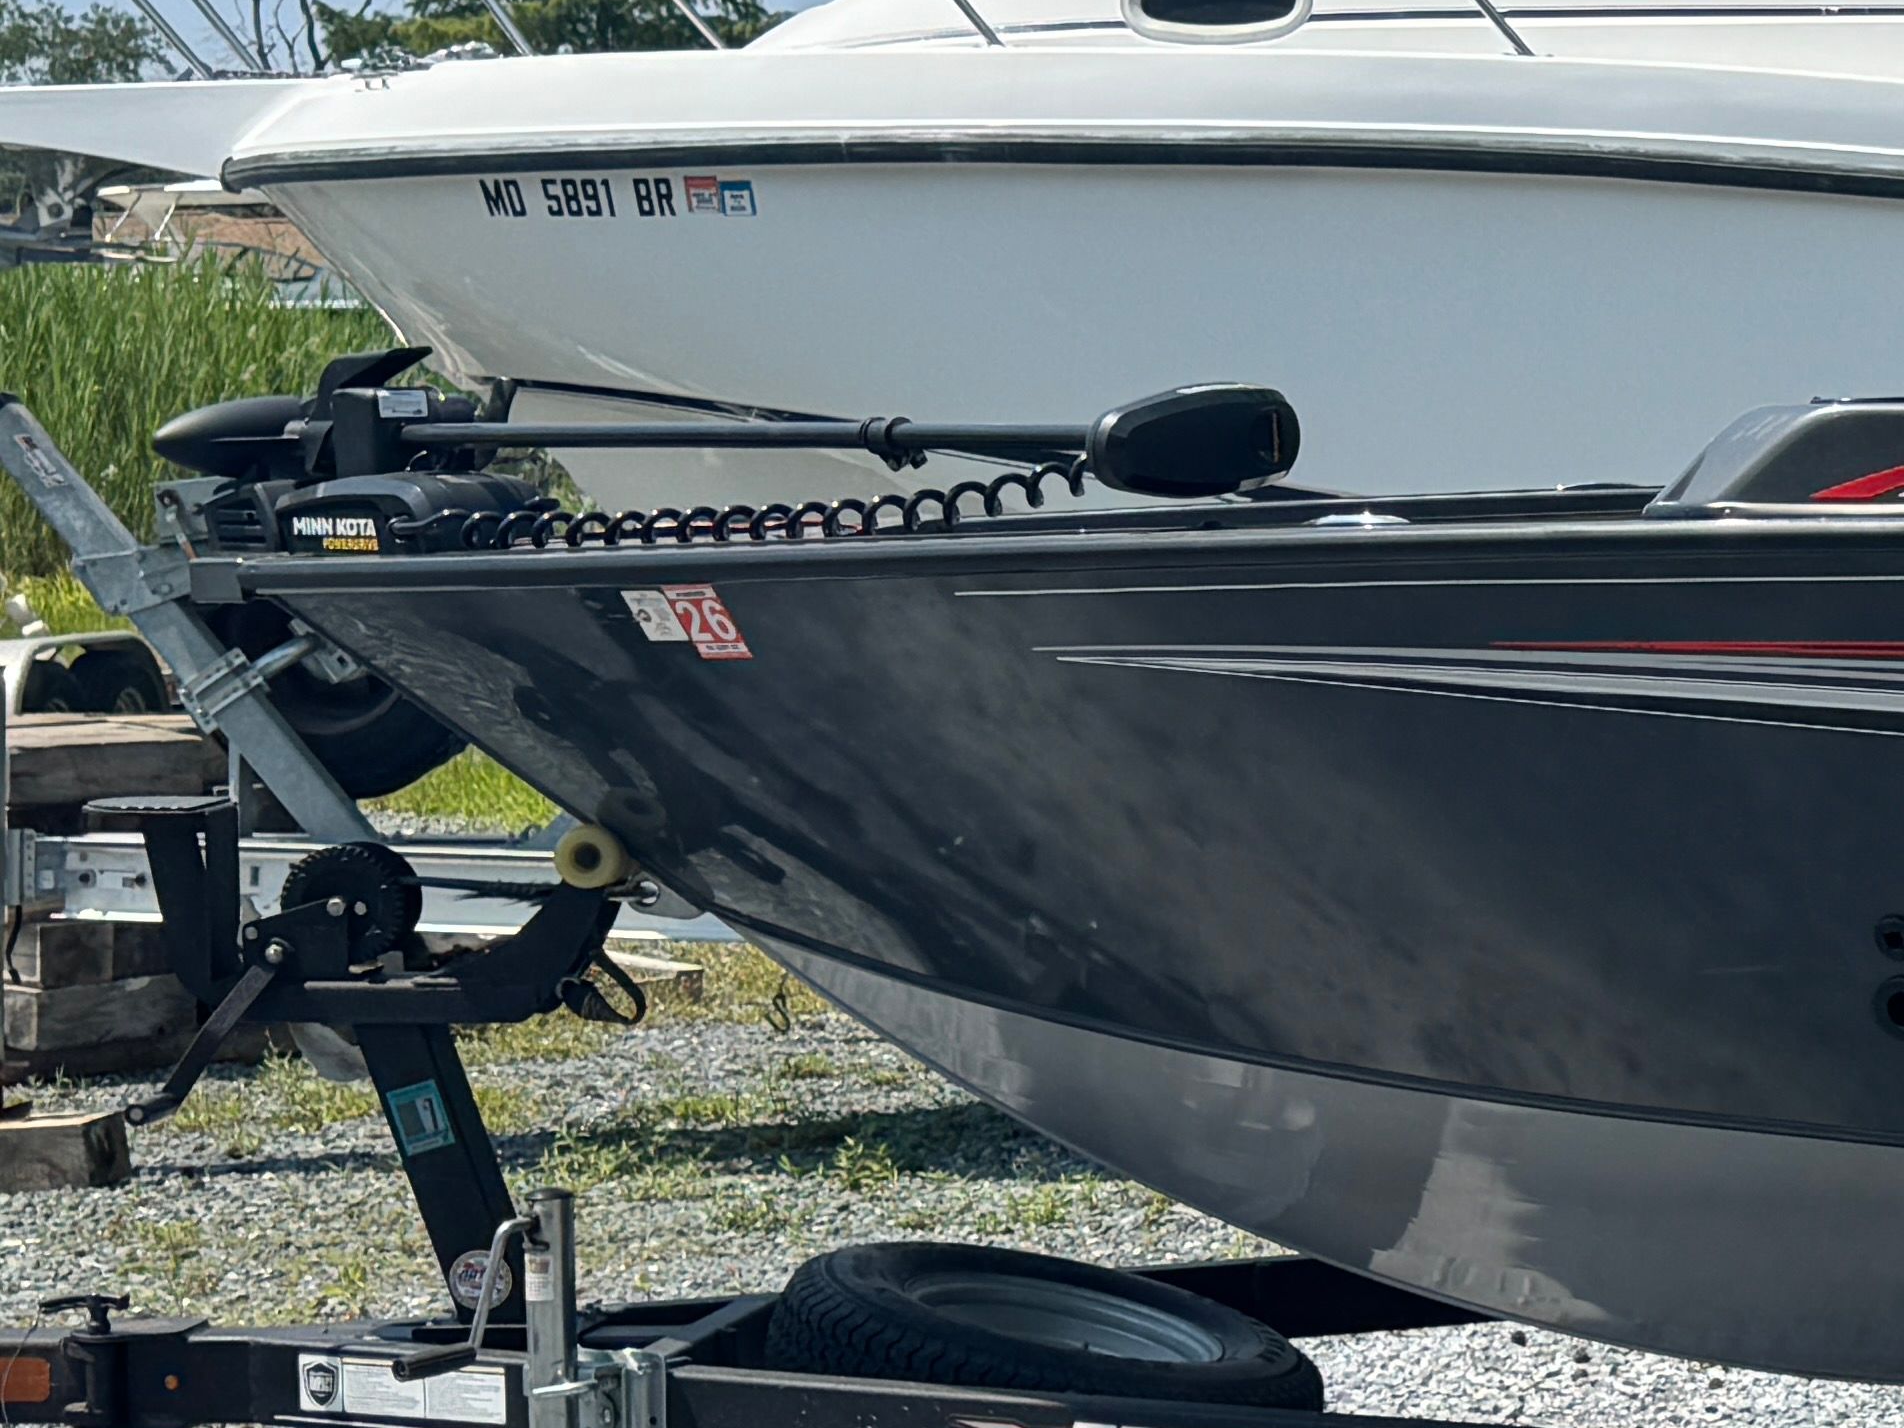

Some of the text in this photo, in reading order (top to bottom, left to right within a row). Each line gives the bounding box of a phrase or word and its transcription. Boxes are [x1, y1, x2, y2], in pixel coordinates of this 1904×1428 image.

[479, 178, 527, 217] MD
[540, 178, 616, 217] 5891
[632, 178, 677, 217] BR
[292, 517, 377, 536] MINN KOTA
[674, 598, 737, 642] 26
